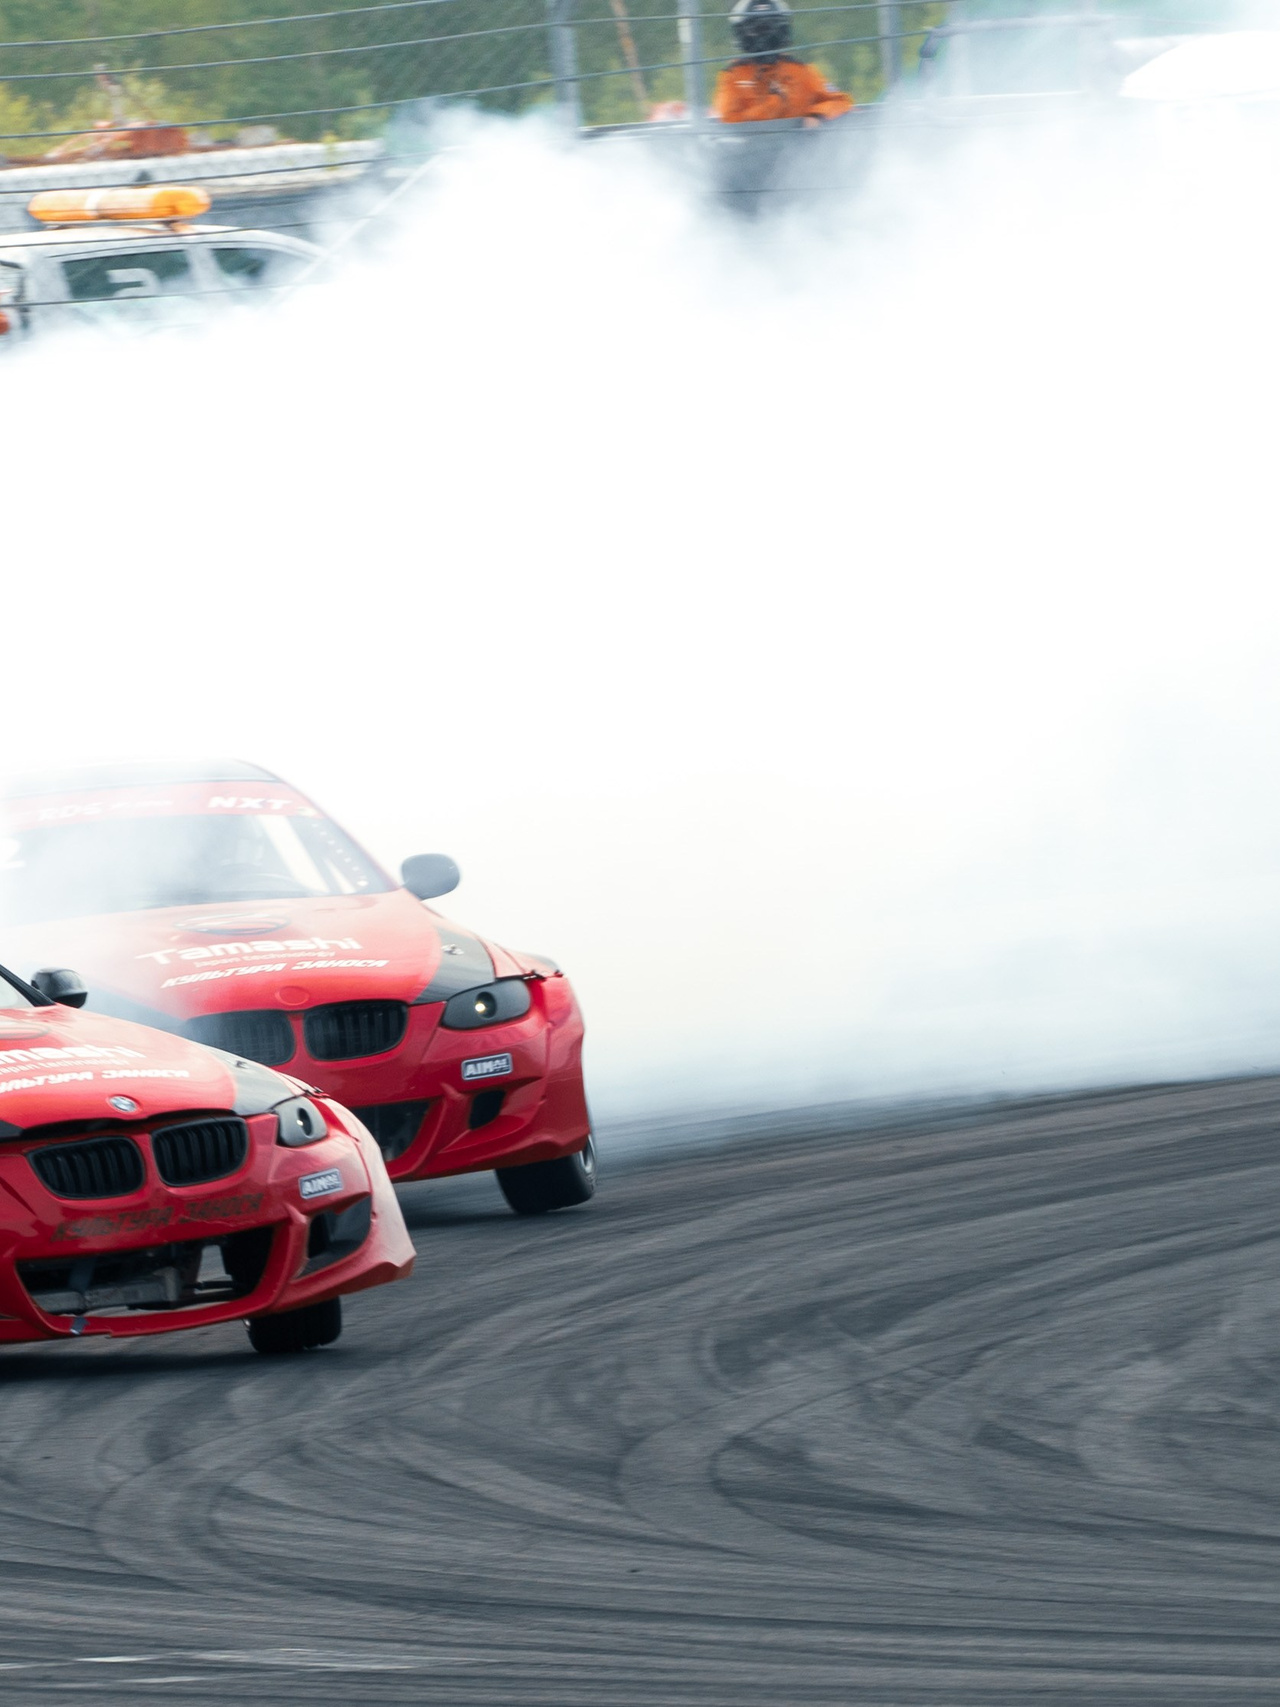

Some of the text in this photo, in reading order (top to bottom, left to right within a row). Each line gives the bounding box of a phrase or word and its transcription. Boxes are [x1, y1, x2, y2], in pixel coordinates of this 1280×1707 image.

[207, 796, 293, 810] NXT
[134, 936, 363, 965] Tamashi
[160, 960, 389, 989] КУЛЬТУРА ЗАНОСА
[101, 1069, 190, 1079] ЗАНОСА
